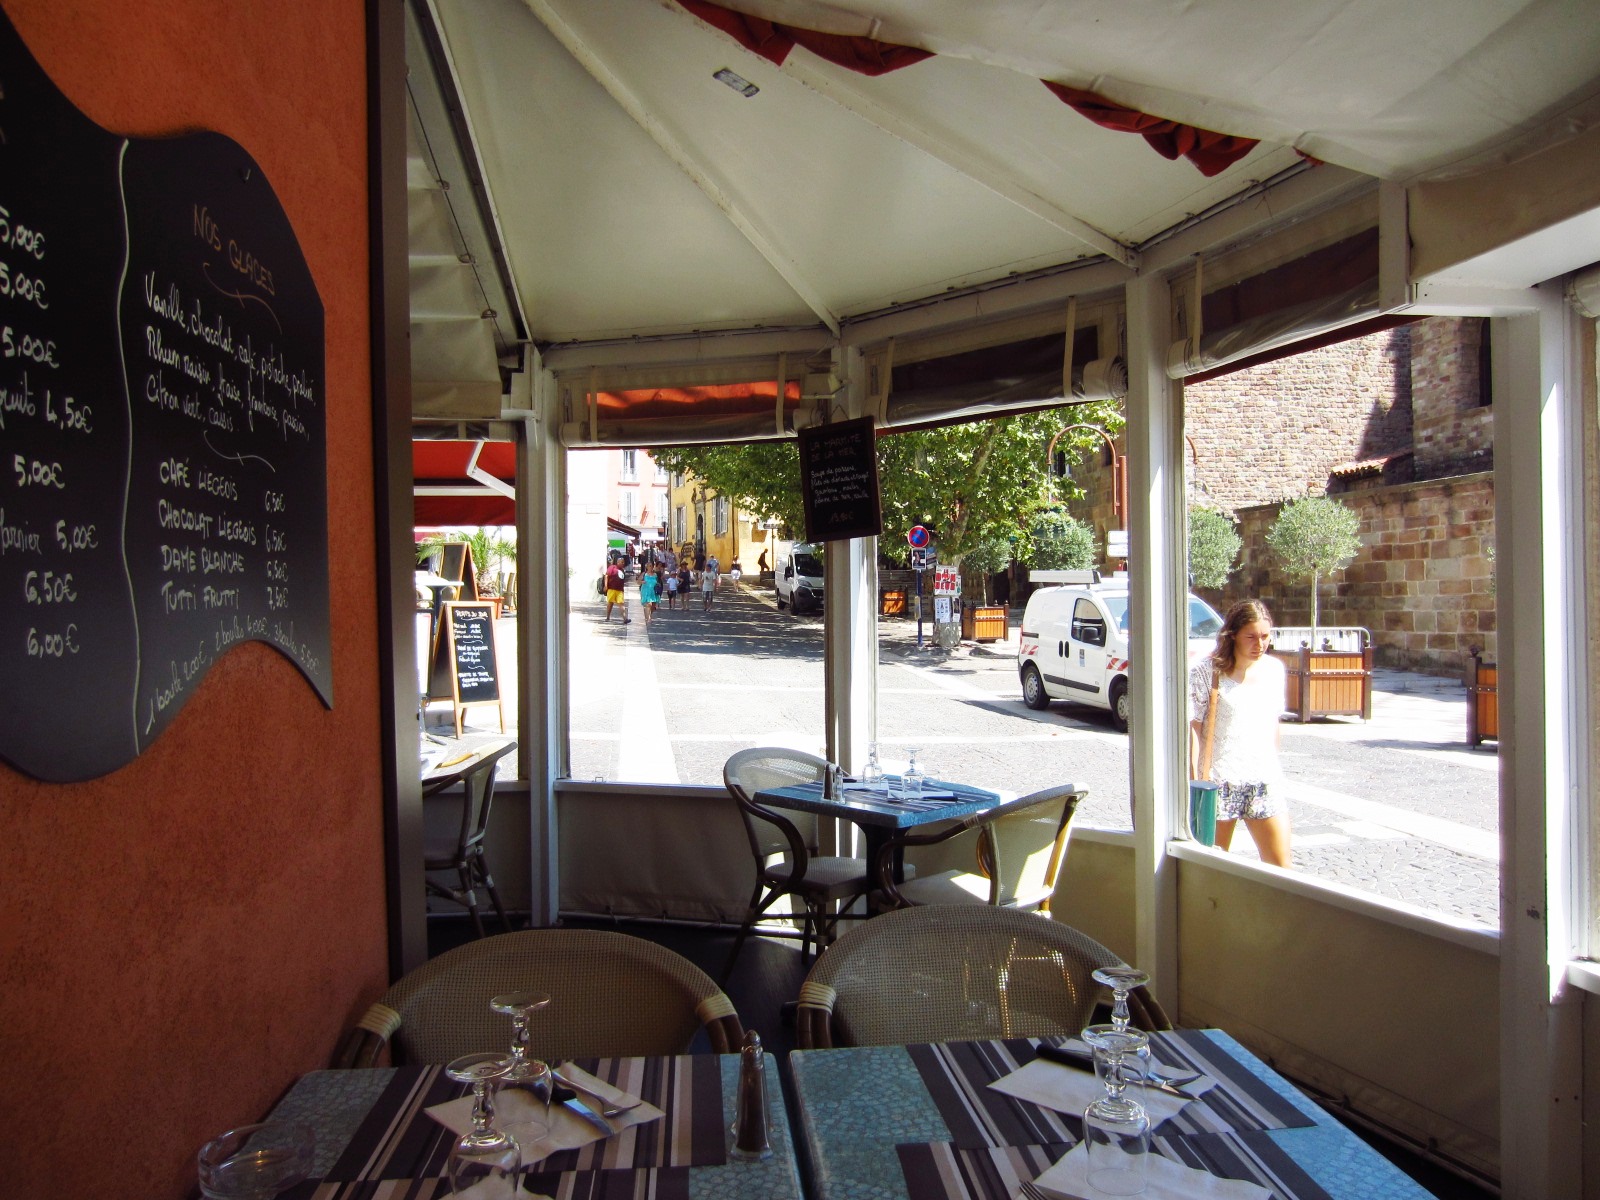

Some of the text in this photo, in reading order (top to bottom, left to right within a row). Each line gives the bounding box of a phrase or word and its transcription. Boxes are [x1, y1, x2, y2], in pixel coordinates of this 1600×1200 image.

[193, 203, 275, 296] NOS GLACES
[0, 261, 49, 310] 5,00€
[2, 326, 60, 369] 5,00€
[147, 326, 181, 370] Rhum
[147, 370, 179, 410] Citron
[47, 390, 93, 434] 4,50€
[14, 454, 65, 489] 5,00€
[160, 457, 191, 489] CAFÉ
[56, 520, 98, 553] 5,00€
[159, 499, 213, 540] CHOCOLAT
[161, 545, 197, 573] DAME
[201, 547, 245, 575] BLANCHE
[25, 570, 78, 605] 6,50€
[27, 623, 80, 658] 6,00€
[156, 661, 183, 712] boule
